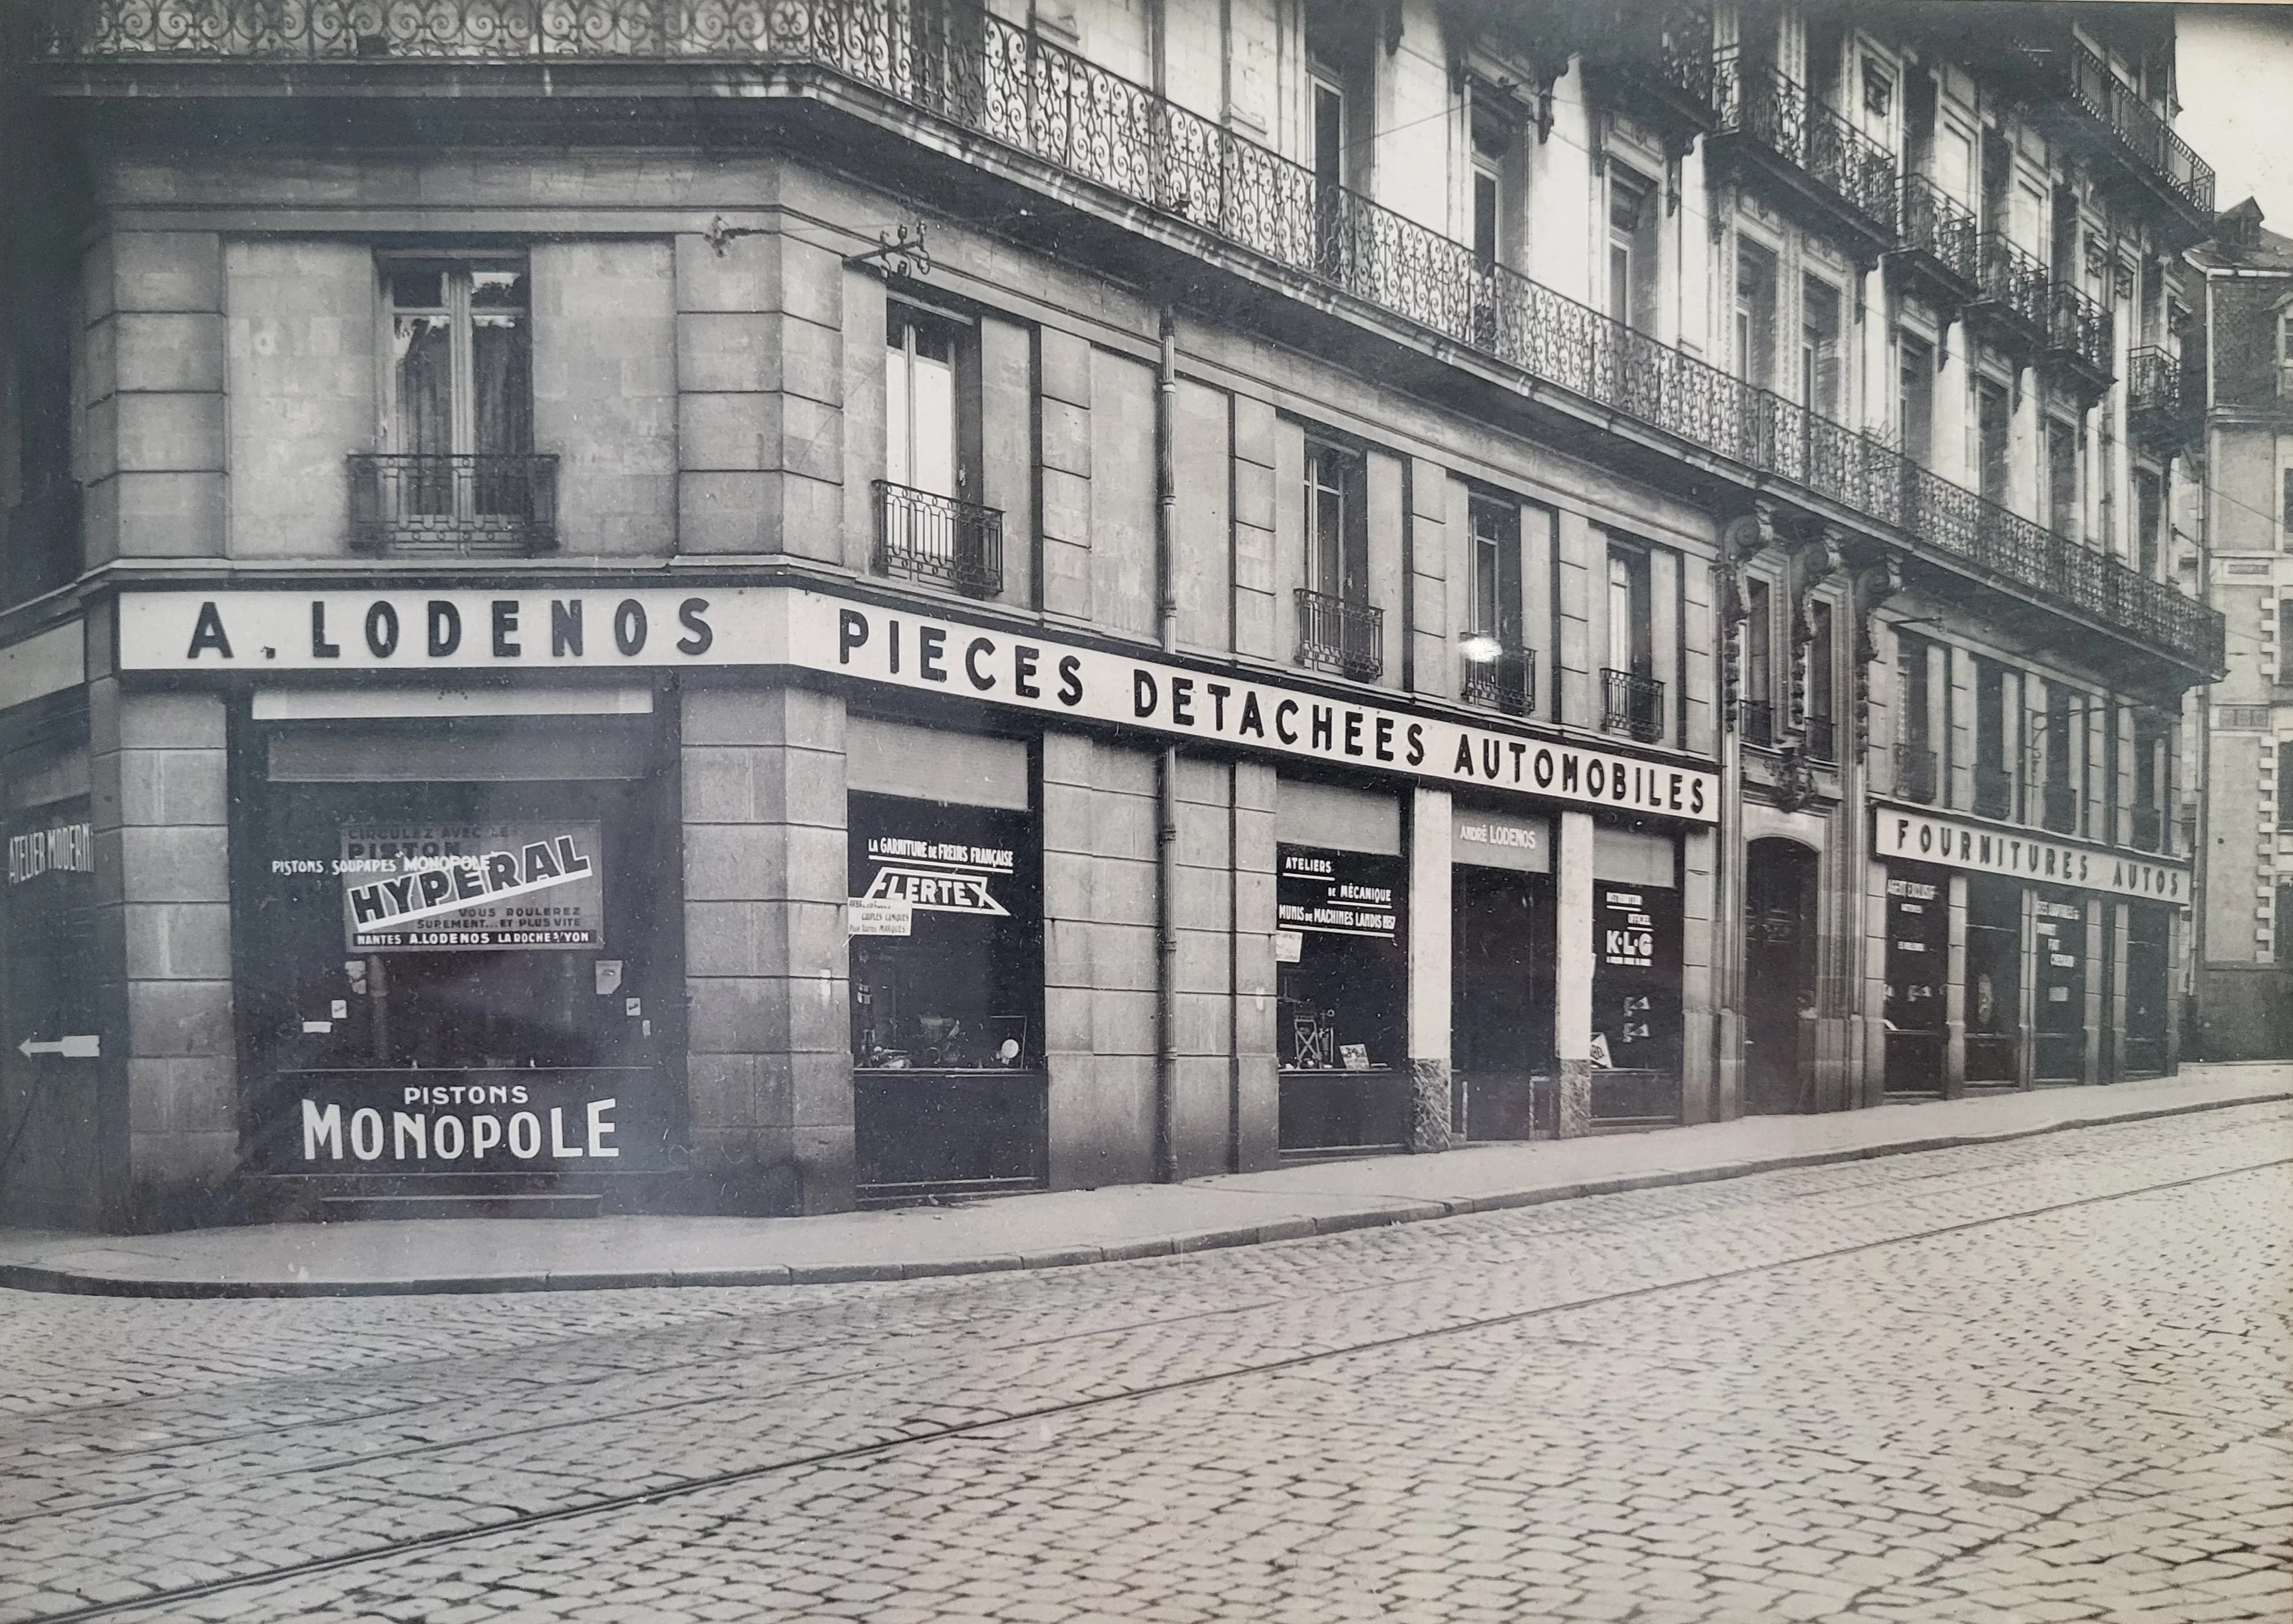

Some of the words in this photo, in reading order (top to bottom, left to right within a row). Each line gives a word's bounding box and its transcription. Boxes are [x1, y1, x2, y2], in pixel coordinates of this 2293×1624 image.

[188, 601, 275, 659] A.
[312, 598, 713, 659] LODENOS
[839, 608, 1083, 706] PIECES
[1134, 669, 1425, 766] DETACHEES
[1454, 733, 1705, 815] AUTOMOBILES
[1460, 824, 1487, 843] ANDRÉ
[1490, 825, 1536, 849] LODENOS
[9, 832, 46, 886] ATELIER
[348, 842, 460, 859] PISTON
[868, 839, 878, 852] LA
[880, 838, 927, 858] GARNITURE
[928, 846, 937, 859] DE
[938, 843, 968, 863] FREINS
[970, 847, 1013, 868] FRANÇAISE
[1897, 820, 2088, 882] FOURNITURES
[2112, 862, 2179, 897] AUTOS
[332, 860, 397, 875] SOUPAPES
[1286, 857, 1331, 873] ATELIERS
[347, 834, 592, 927] HYPERAL
[1328, 888, 1336, 897] DE
[1340, 883, 1391, 903] MÉCANIQUE
[459, 908, 496, 917] VOUS
[506, 907, 581, 917] ROULEREZ
[500, 919, 513, 928] ET
[518, 918, 550, 927] PLUS
[554, 917, 582, 927] VITE
[1279, 904, 1304, 921] MUNIS
[1305, 913, 1313, 922] DE
[1314, 908, 1353, 925] MACHINES
[1355, 912, 1381, 929] LANDIS
[357, 933, 402, 945] NANTES
[498, 932, 512, 943] LA
[514, 932, 551, 943] ROCHE
[405, 1086, 529, 1104] PISTONS
[302, 1098, 619, 1160] MONOPOLE
